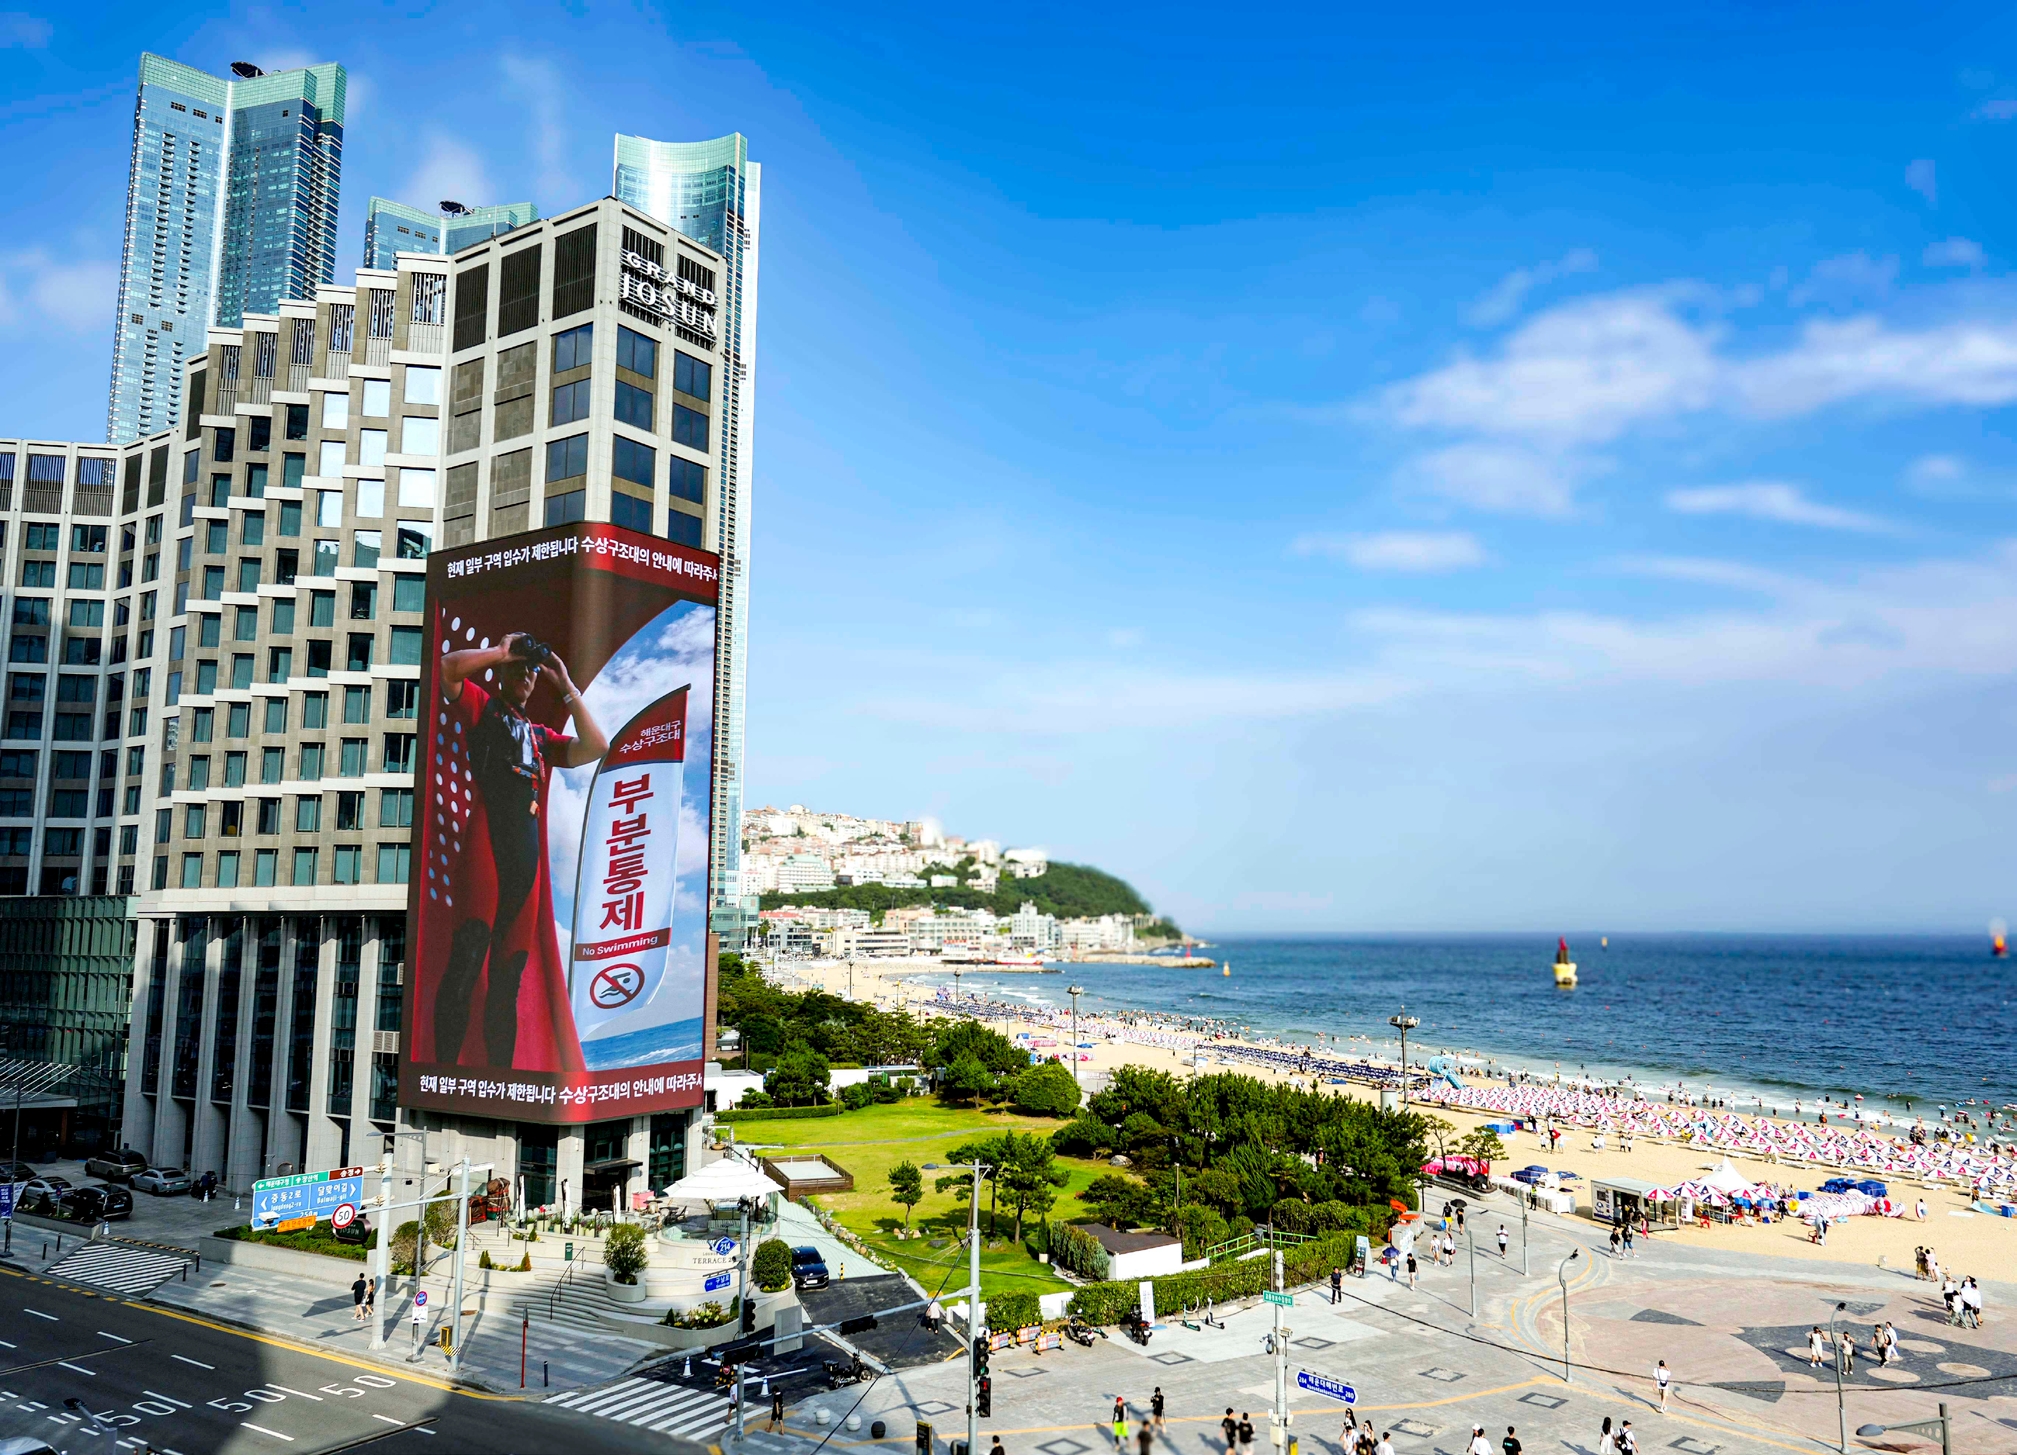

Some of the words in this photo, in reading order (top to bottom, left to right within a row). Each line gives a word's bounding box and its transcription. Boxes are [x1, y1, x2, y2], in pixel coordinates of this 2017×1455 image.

[626, 252, 716, 305] GRAND
[620, 273, 718, 336] JOSUN
[447, 560, 464, 578] 현재
[465, 557, 482, 575] 일부
[484, 552, 502, 570] 구역
[503, 546, 530, 567] 입수가
[531, 536, 578, 561] 제한됩니다
[581, 536, 650, 566] 수상구조대의
[652, 552, 682, 574] 안내에
[619, 728, 680, 754] 수상구조대
[640, 720, 681, 737] 해운대구
[599, 773, 654, 931] 부분통제
[582, 947, 595, 956] No
[597, 935, 658, 955] Swimming
[420, 1074, 438, 1093] 현재
[439, 1076, 456, 1095] 일부
[458, 1078, 476, 1097] 구역
[478, 1080, 506, 1099] 입수가
[507, 1082, 556, 1104] 제한됩니다
[559, 1080, 630, 1105] 수상구조대의
[633, 1076, 664, 1098] 안내에
[271, 1190, 302, 1204] 중동2로
[317, 1183, 348, 1197] 달맞이길
[338, 1210, 350, 1221] 50
[720, 1243, 730, 1251] 214
[692, 1257, 727, 1265] TERRACE
[318, 1374, 397, 1399] 50
[1308, 1376, 1344, 1393] 해운대해변로
[206, 1388, 287, 1413] 50
[92, 1400, 176, 1427] 50
